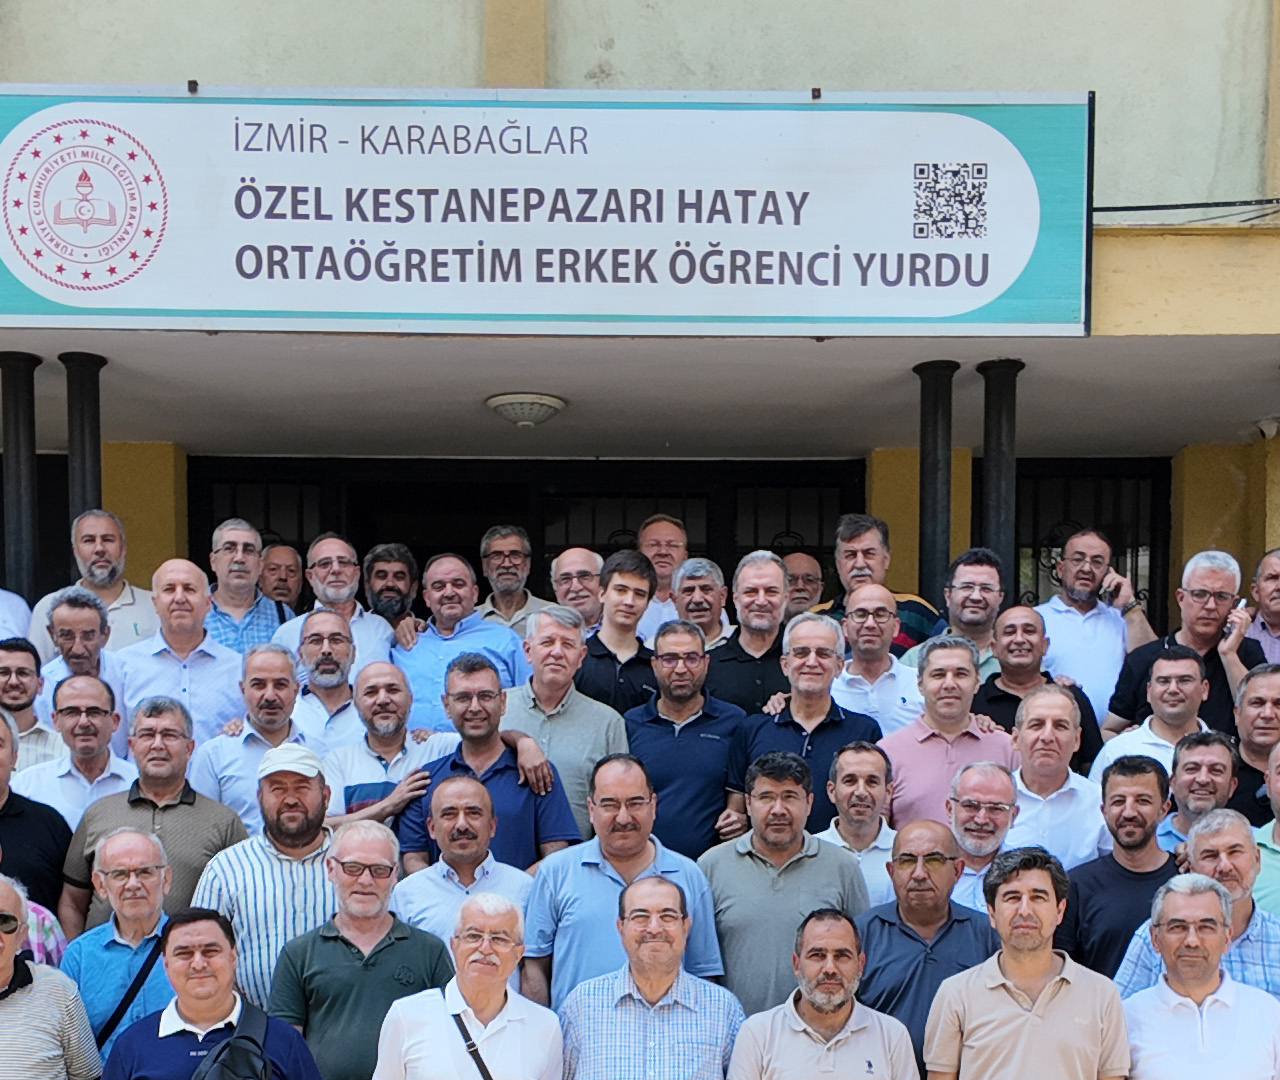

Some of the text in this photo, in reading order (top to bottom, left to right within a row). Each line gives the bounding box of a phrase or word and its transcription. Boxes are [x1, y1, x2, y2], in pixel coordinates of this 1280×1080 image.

[234, 116, 328, 154] İZMİR
[360, 118, 589, 155] KARABAĞLAR
[32, 150, 138, 257] TÜRKİYE CUMHURİYETİ MİLLİ EĞİTİM BAKANLIĞI
[234, 176, 811, 226] ÖZEL KESTANEPAZARI HATAY
[235, 238, 990, 288] ORTAÖĞRETİM ERKEK ÖĞRENCİ YURDU
